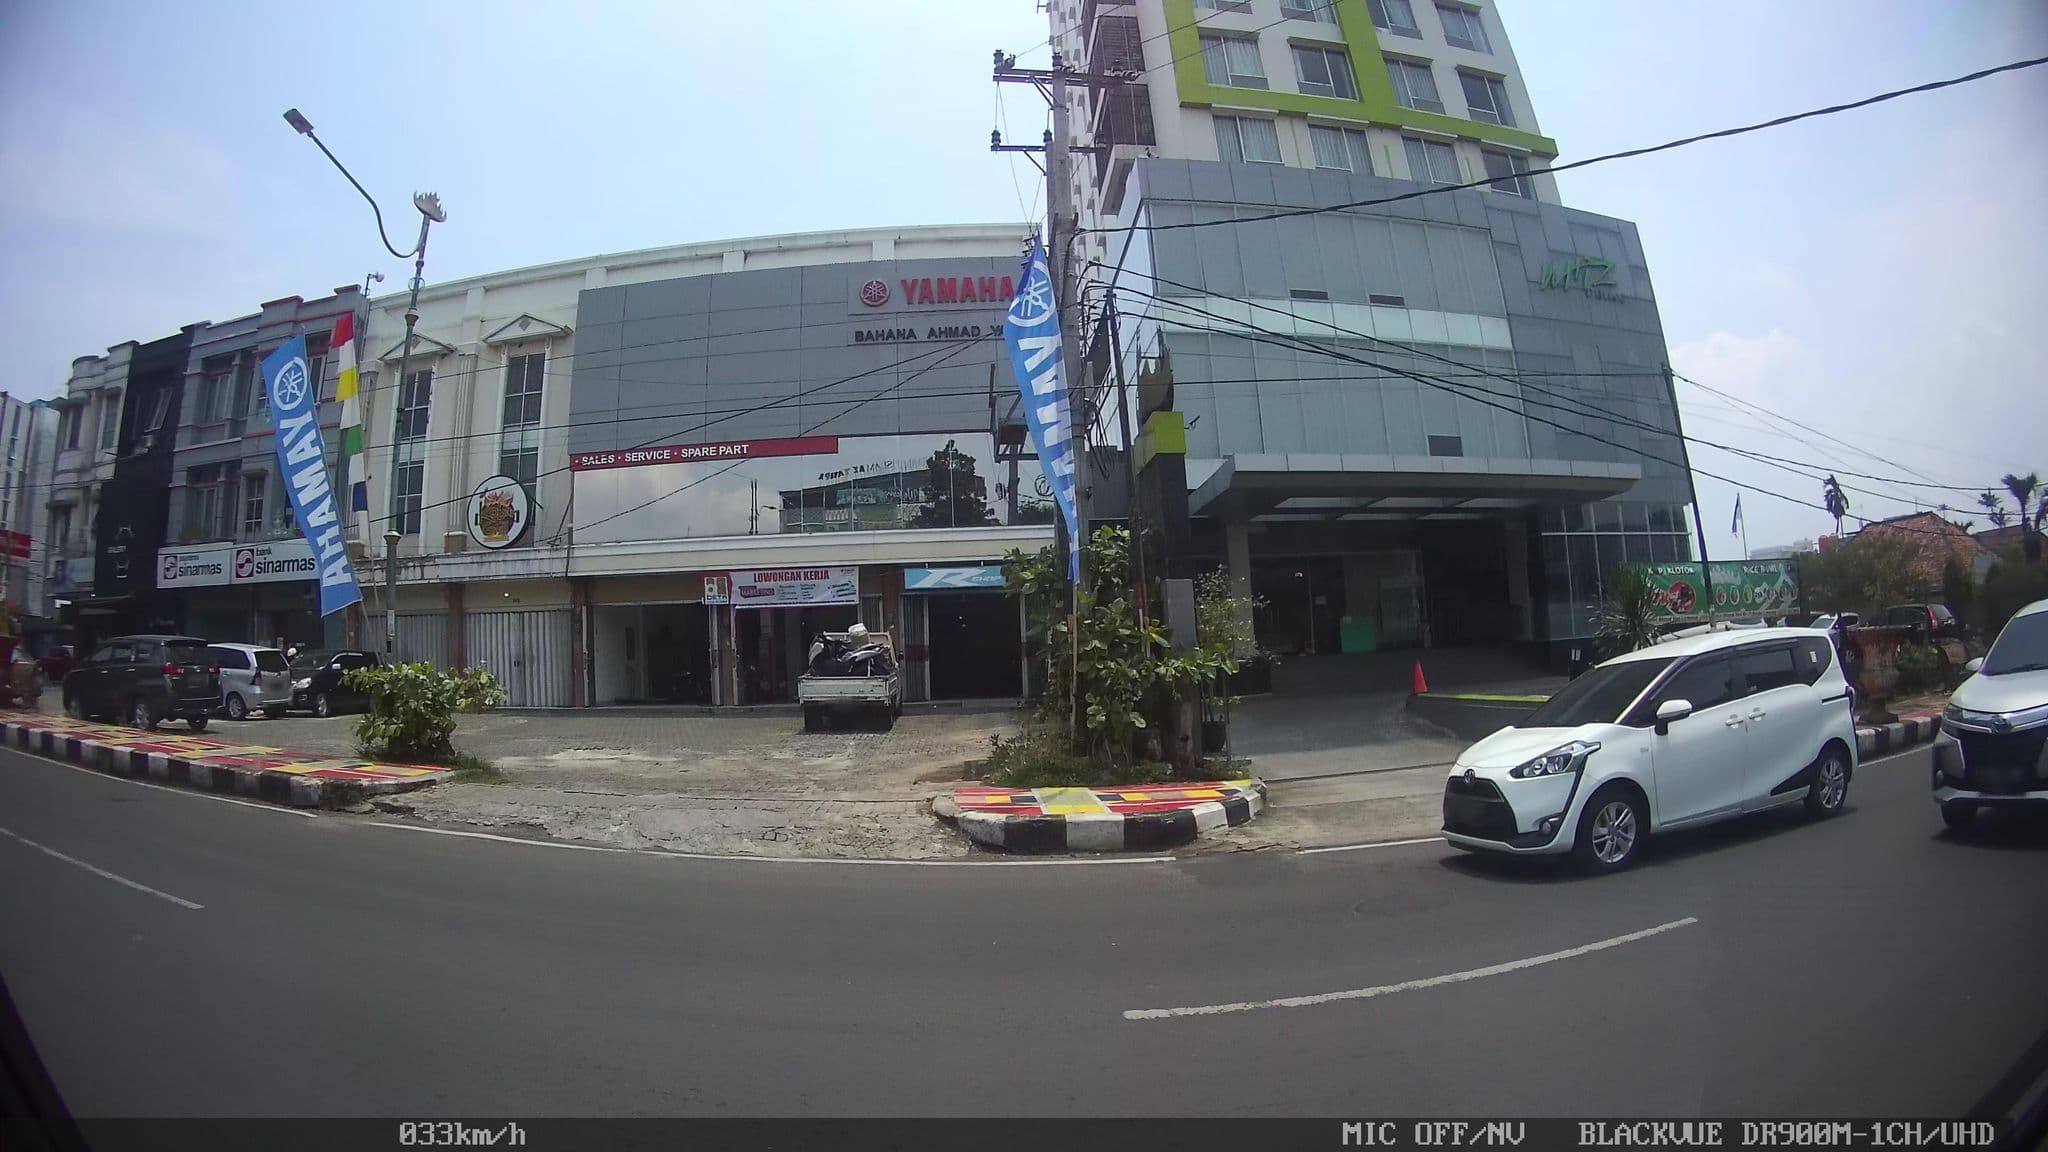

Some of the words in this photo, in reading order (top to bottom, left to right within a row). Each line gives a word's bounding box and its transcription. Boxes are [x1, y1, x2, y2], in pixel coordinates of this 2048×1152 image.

[901, 276, 1015, 305] YAMAHA
[855, 327, 917, 342] BAHANA
[927, 325, 981, 339] AHMAD
[582, 454, 615, 466] SALES
[625, 450, 671, 462] SERVICE
[681, 447, 717, 458] SPARE
[719, 445, 750, 455] PART
[178, 562, 222, 578] sinarmas
[255, 556, 316, 575] sinarmas
[754, 570, 800, 583] LOWONGAN
[803, 569, 830, 581] KERJA
